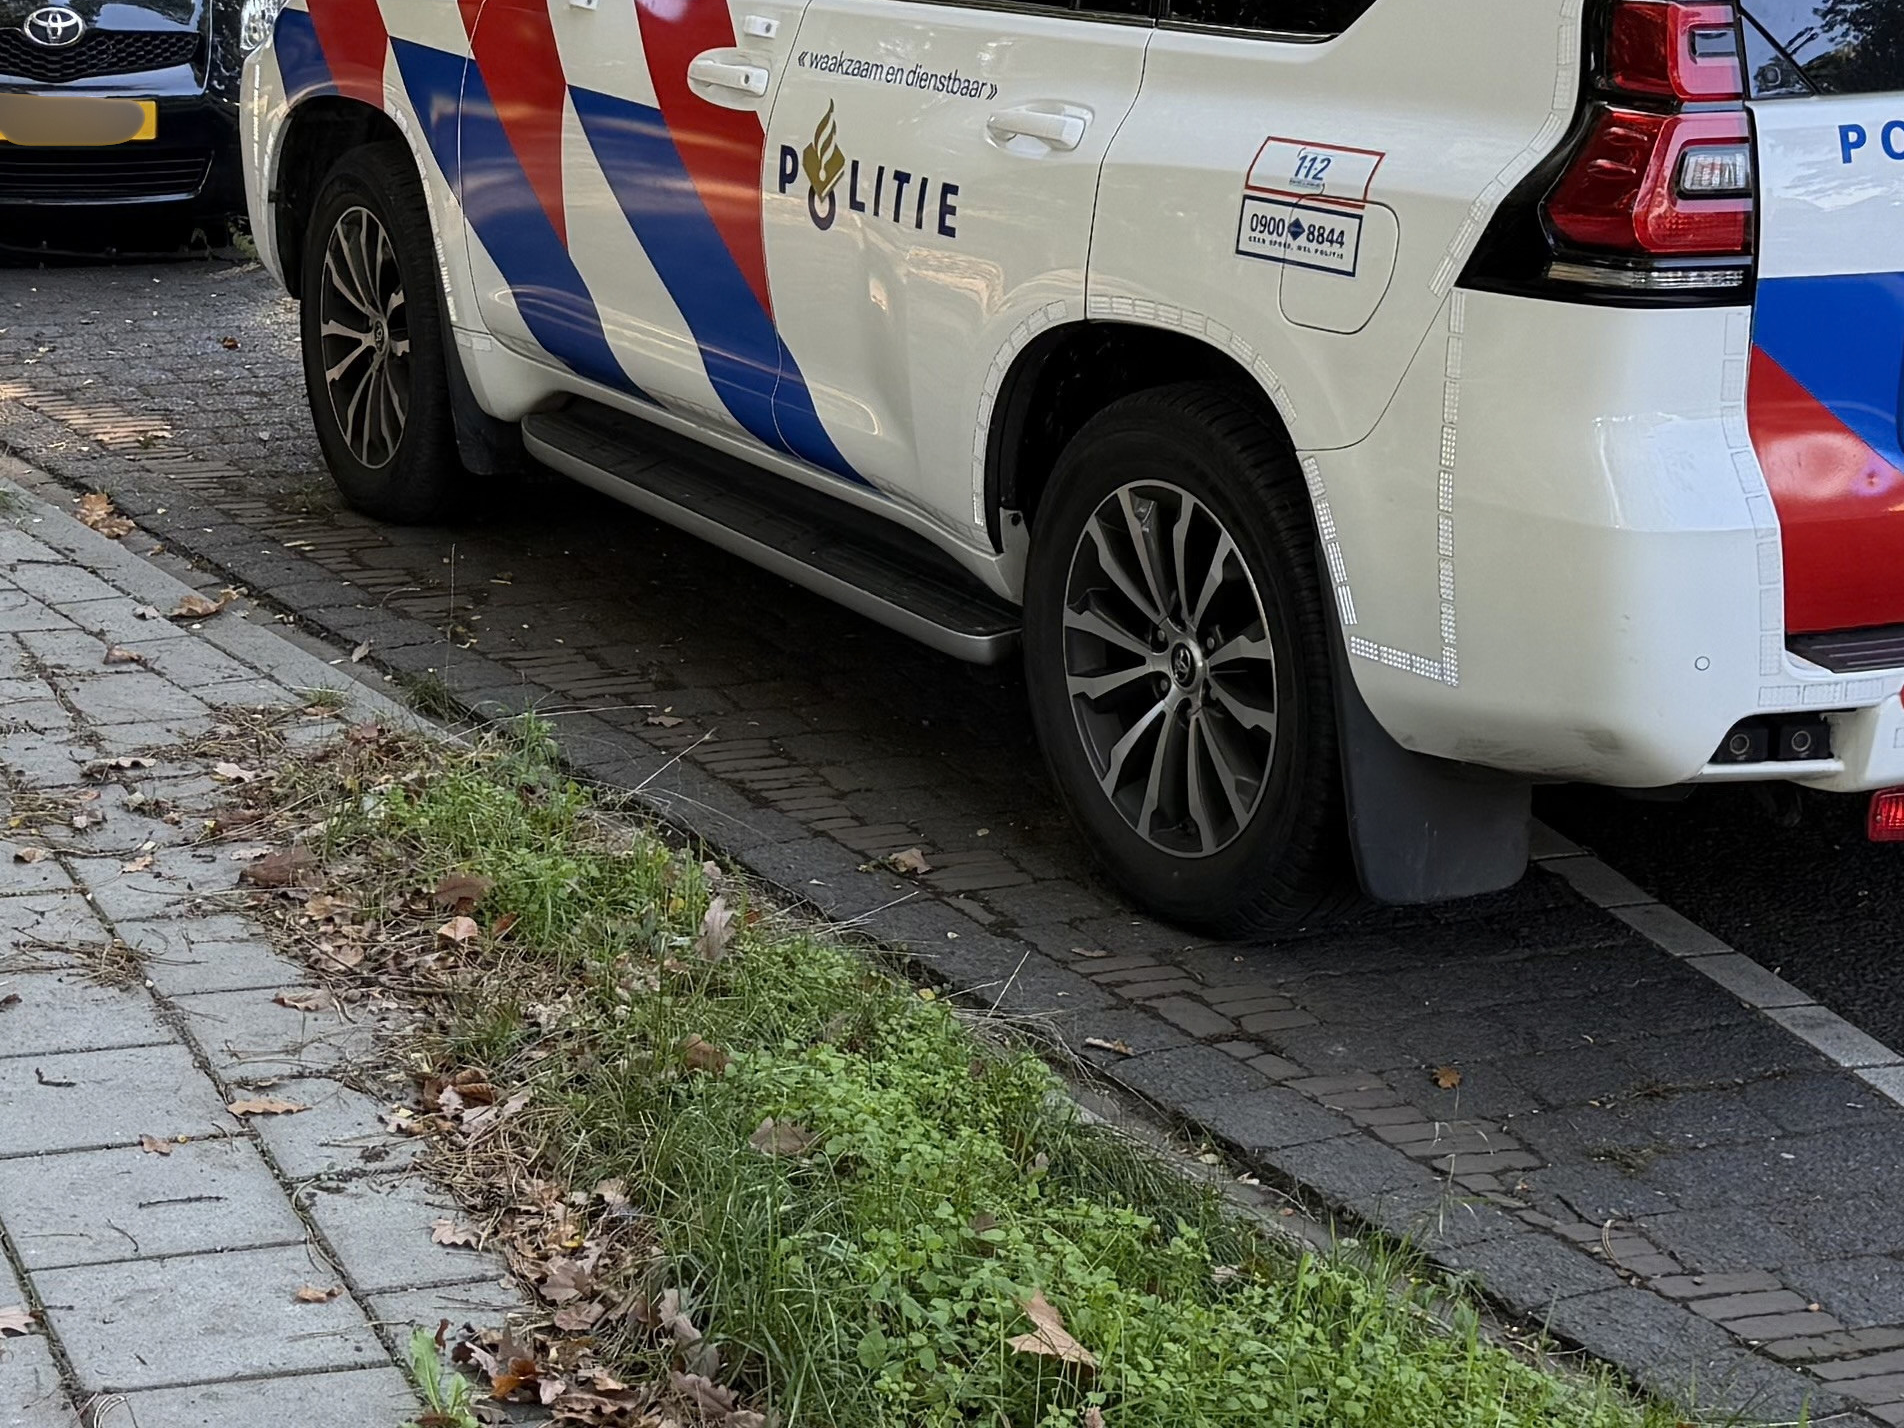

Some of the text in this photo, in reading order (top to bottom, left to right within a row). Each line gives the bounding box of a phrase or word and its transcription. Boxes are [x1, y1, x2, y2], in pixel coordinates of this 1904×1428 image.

[809, 50, 883, 81] waakzaam
[885, 65, 905, 84] en
[905, 63, 987, 99] dienstbaar
[779, 144, 960, 238] POLITIE
[1251, 213, 1345, 248] 0900 8844
